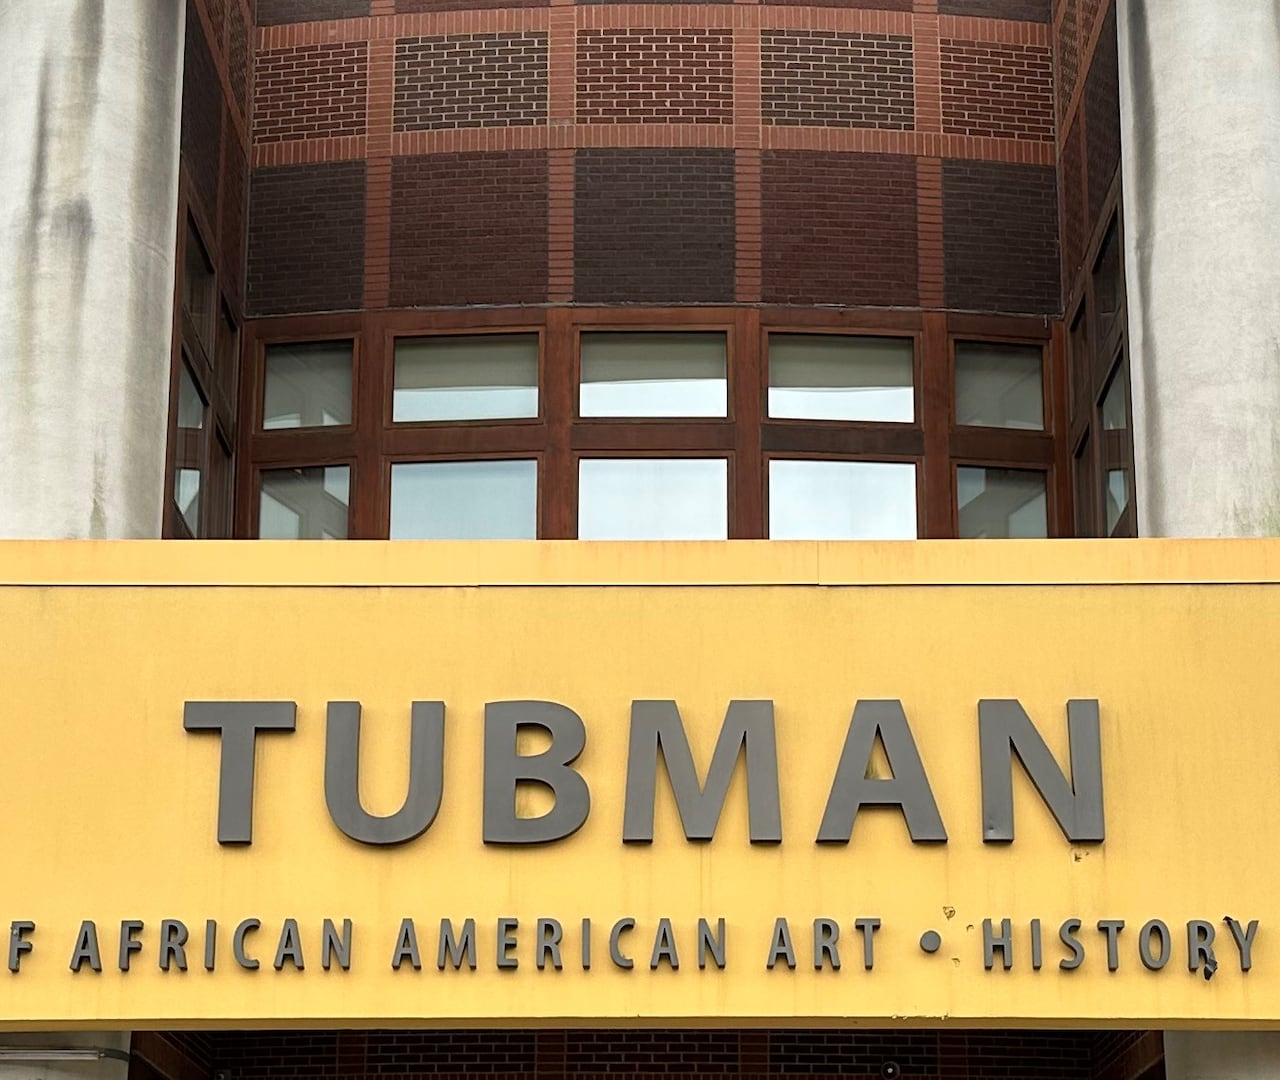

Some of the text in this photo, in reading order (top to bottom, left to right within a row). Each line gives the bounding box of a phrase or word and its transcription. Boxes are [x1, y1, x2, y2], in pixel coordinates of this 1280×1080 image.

[182, 699, 1106, 853] TUBMAN
[69, 918, 353, 975] AFRICAN
[391, 917, 727, 973] AMERICAN
[766, 917, 882, 973] ART
[982, 916, 1260, 981] HISTORY
